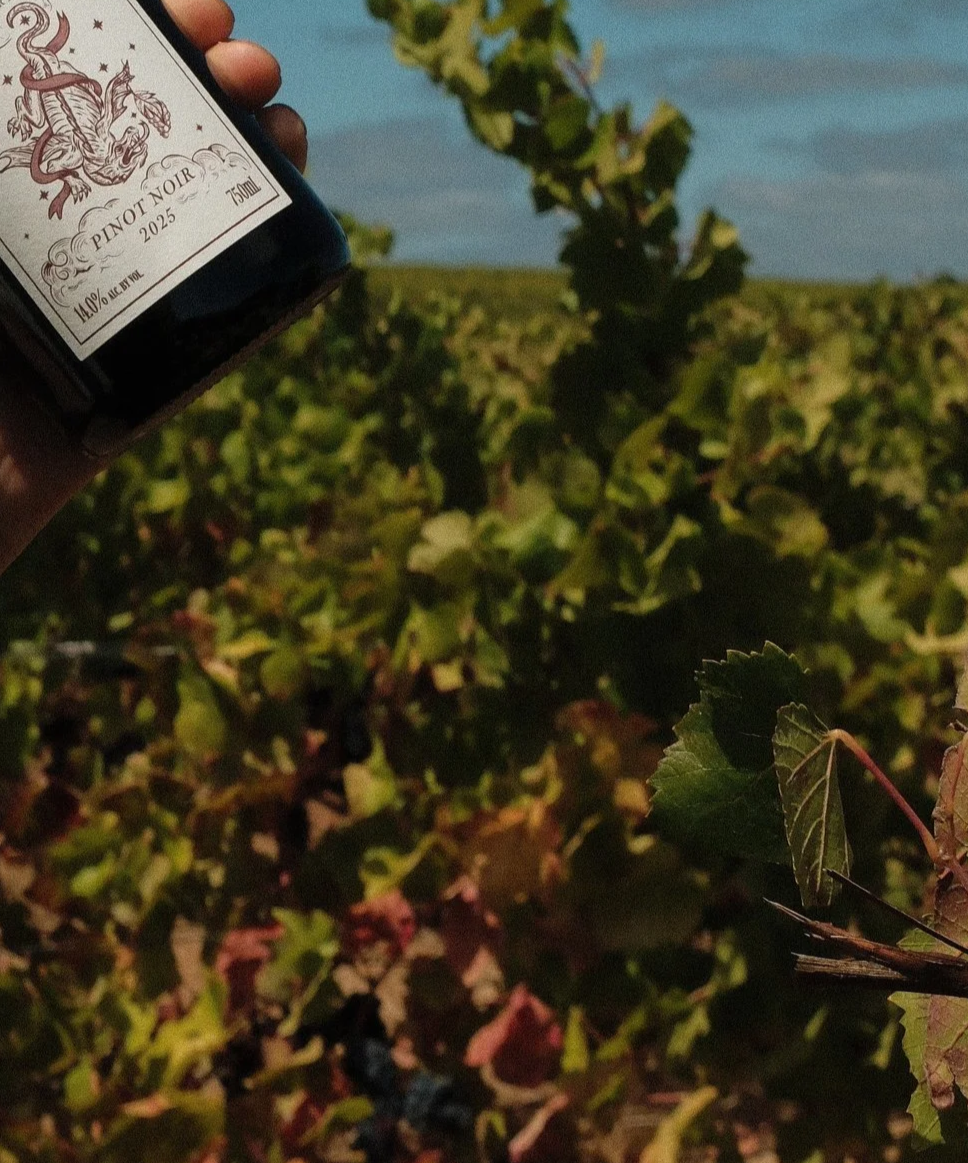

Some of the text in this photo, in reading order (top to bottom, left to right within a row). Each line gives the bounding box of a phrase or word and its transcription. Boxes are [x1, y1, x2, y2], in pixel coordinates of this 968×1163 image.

[90, 167, 196, 251] PINOT NOIR
[139, 206, 176, 243] 2025
[73, 288, 108, 323] 14.0%
[119, 278, 131, 291] BY
